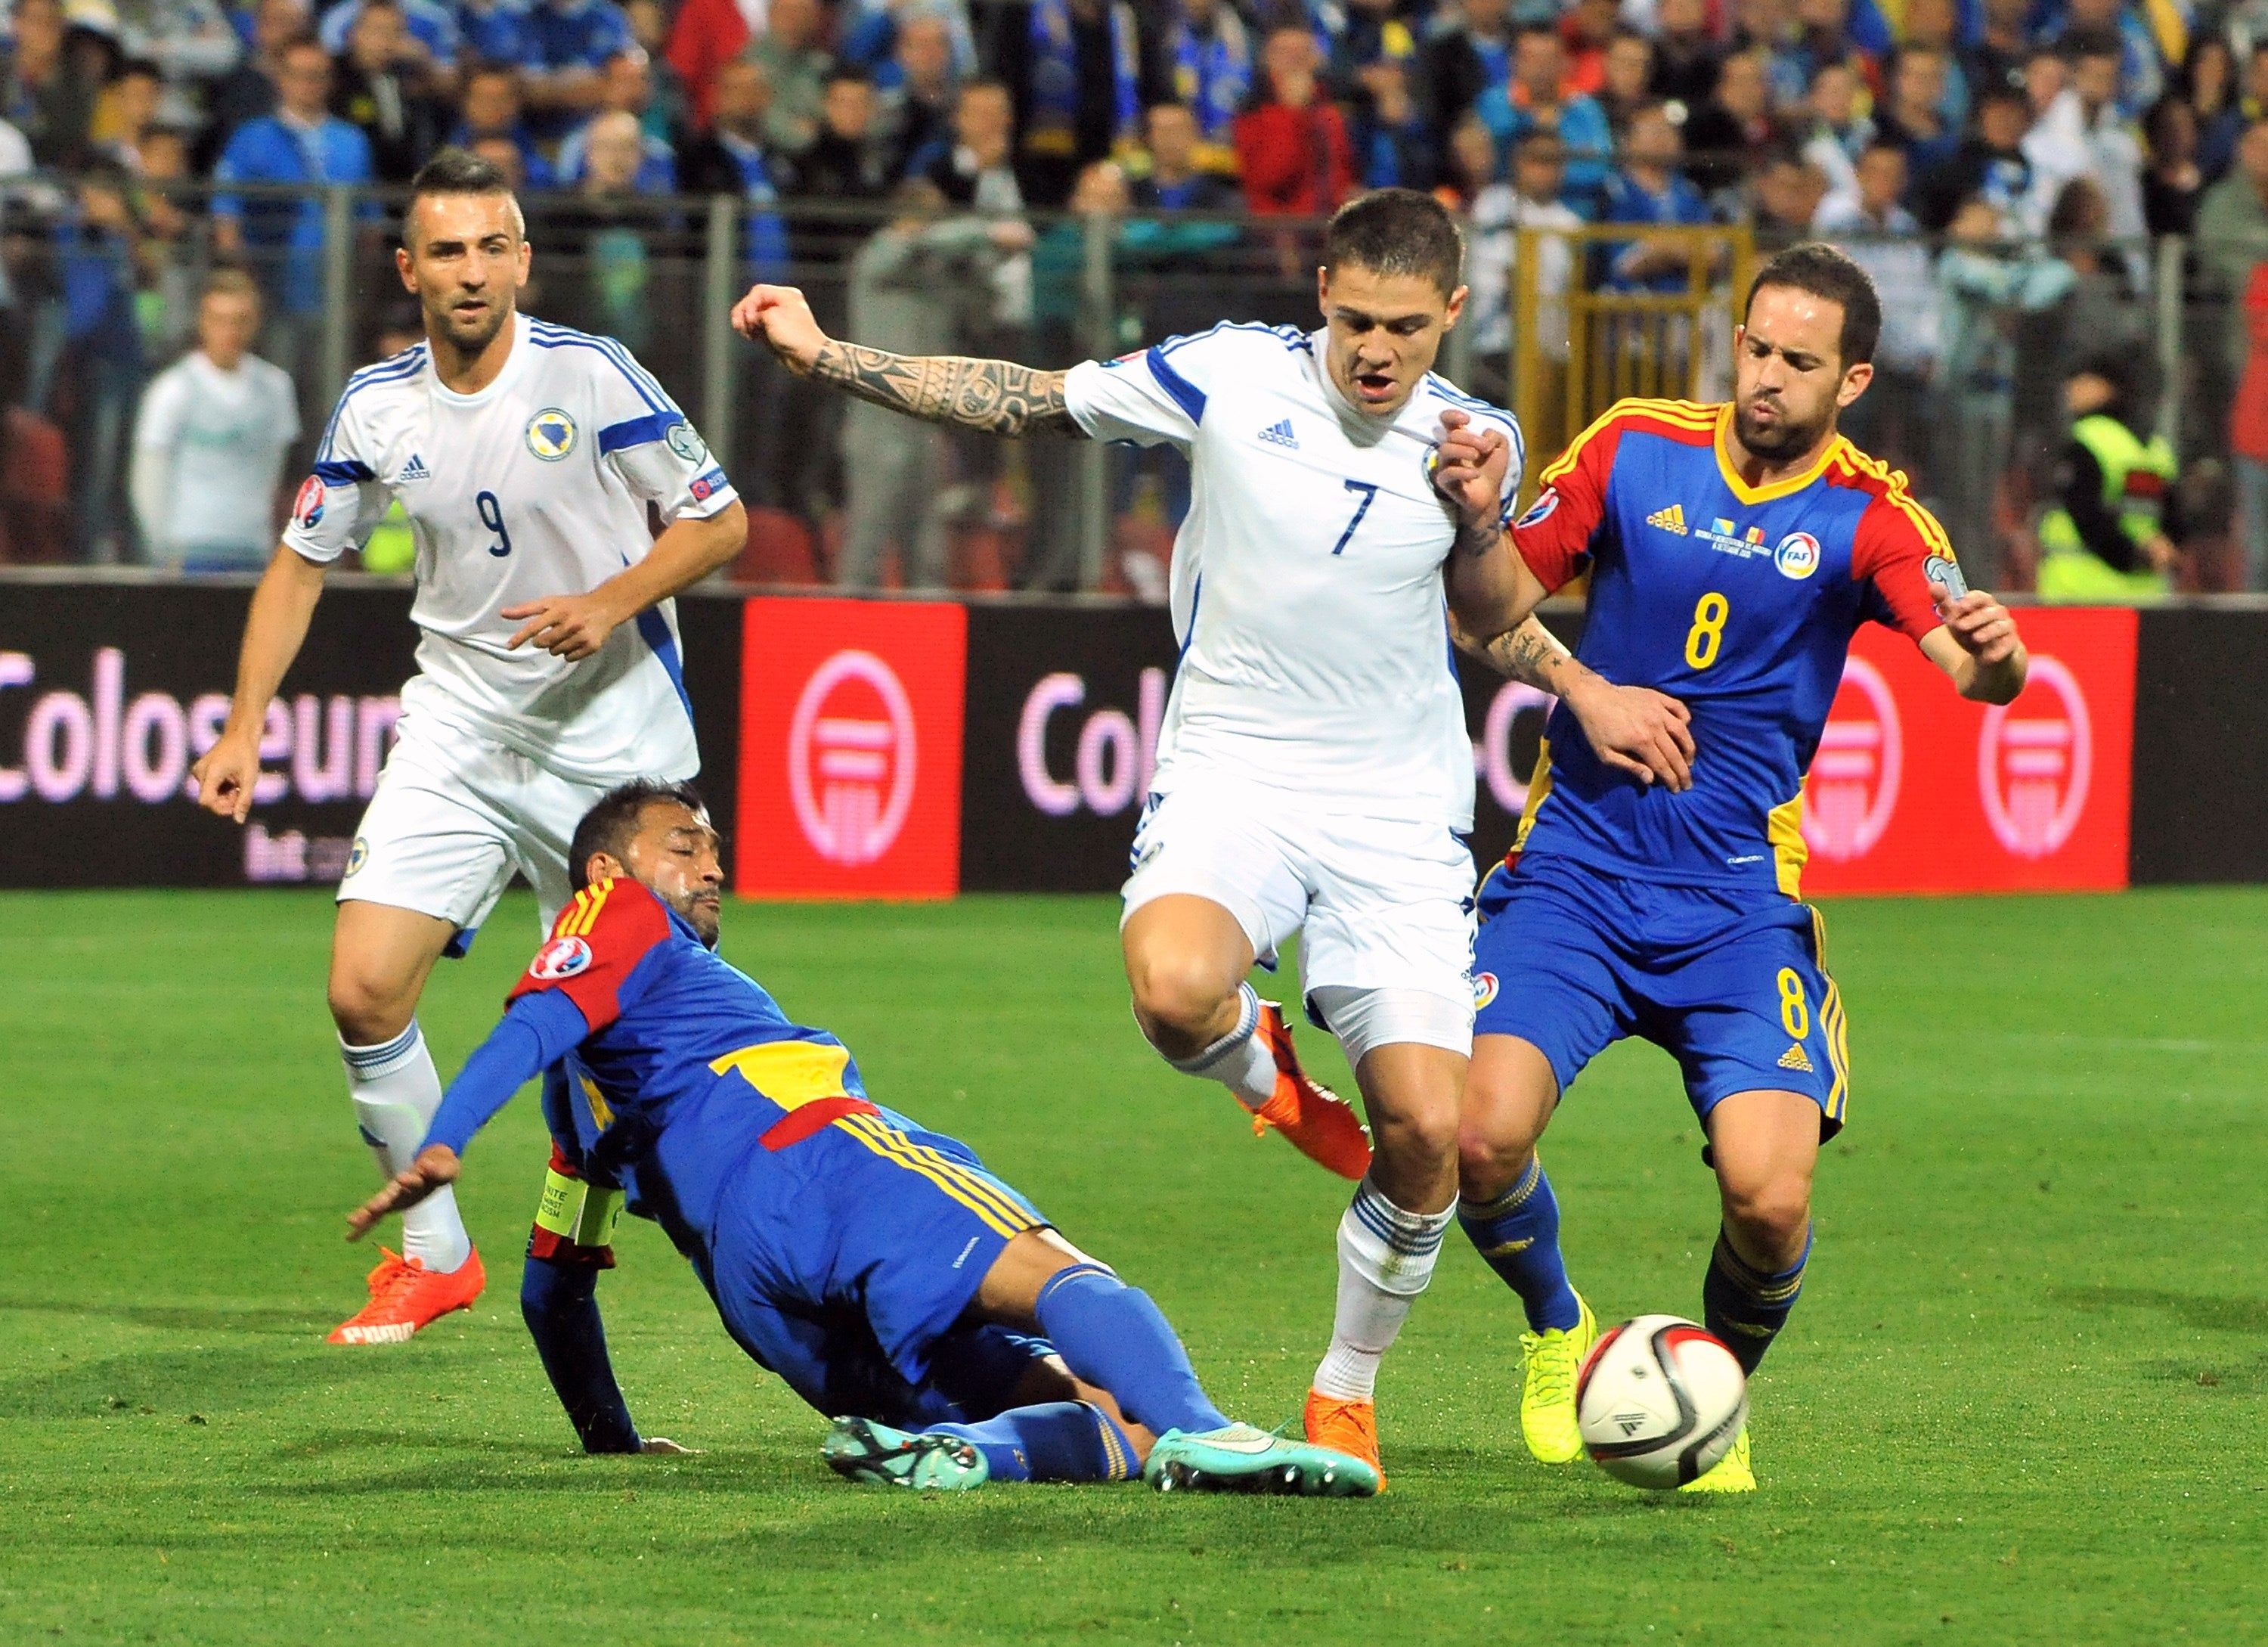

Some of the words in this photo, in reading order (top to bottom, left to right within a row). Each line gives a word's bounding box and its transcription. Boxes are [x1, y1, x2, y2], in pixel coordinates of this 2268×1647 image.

[400, 468, 431, 481] adidas
[1258, 431, 1300, 449] adidas
[476, 490, 512, 557] 9
[1332, 479, 1378, 555] 7
[1786, 552, 1809, 561] FAF
[1684, 591, 1730, 669] 8
[1017, 668, 1167, 817] Col
[1777, 967, 1809, 1040] 8
